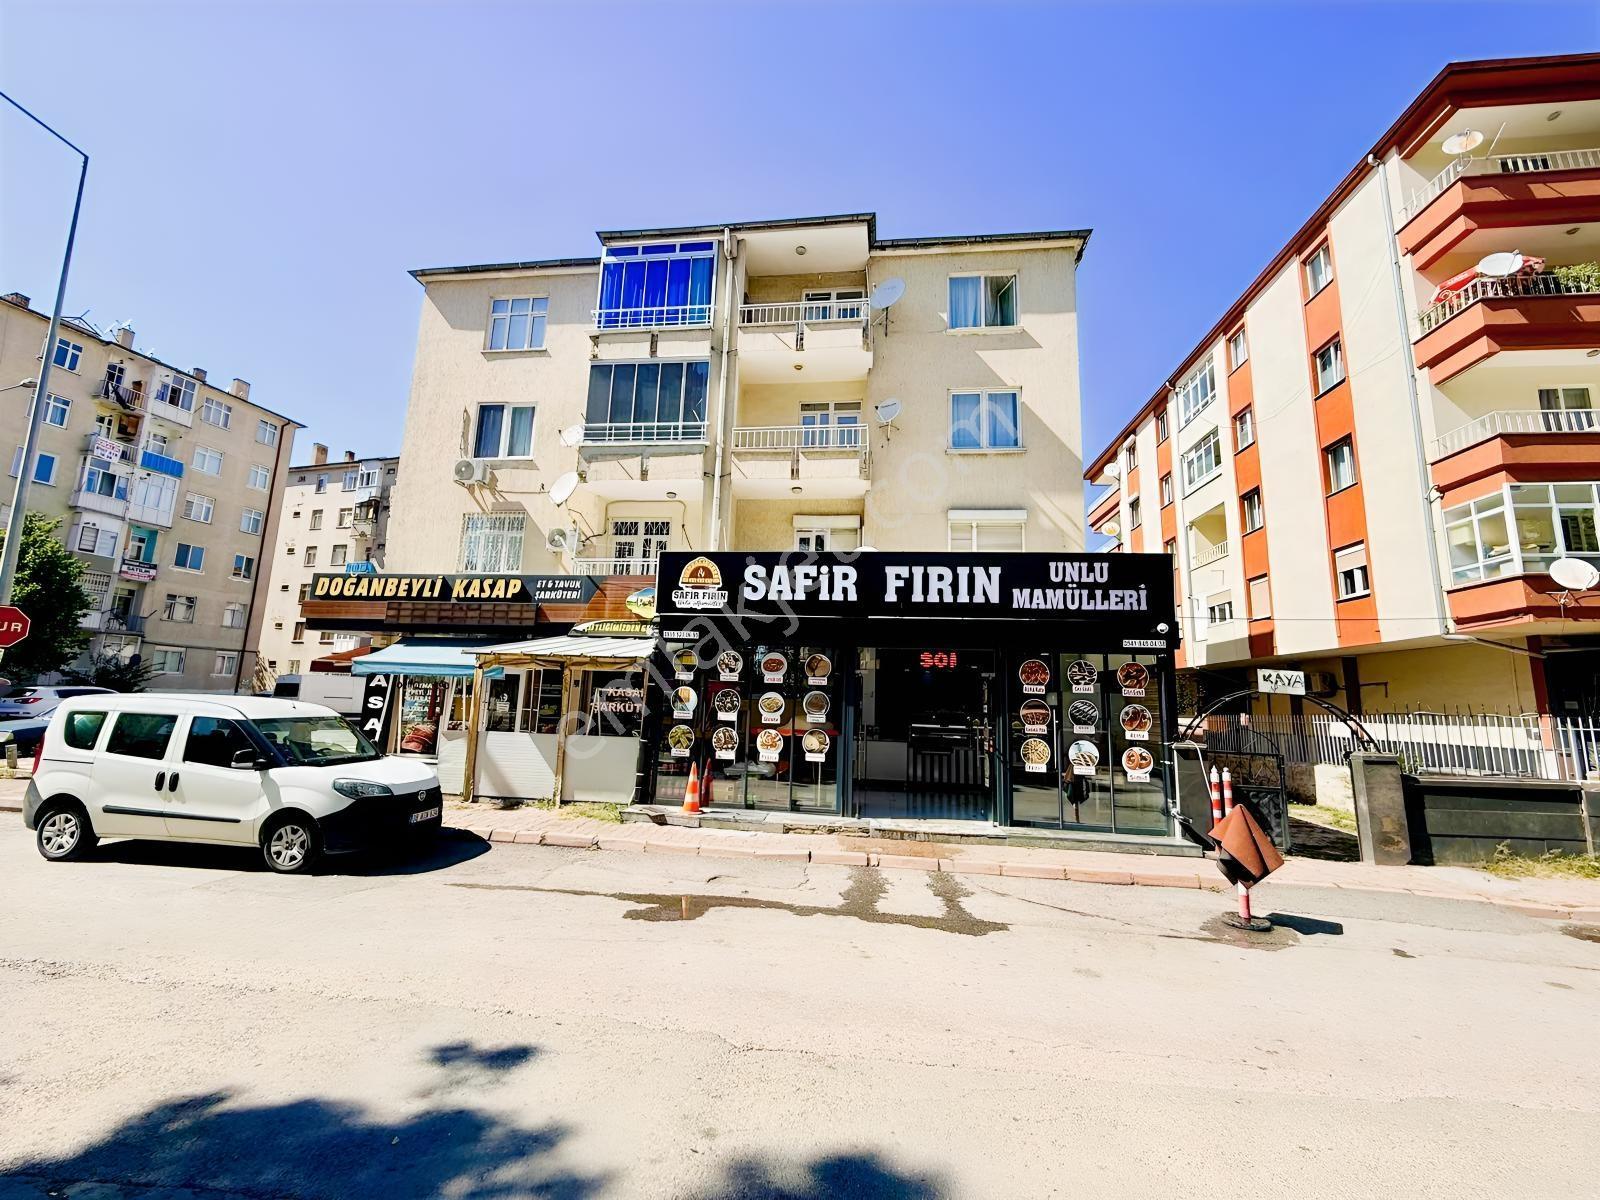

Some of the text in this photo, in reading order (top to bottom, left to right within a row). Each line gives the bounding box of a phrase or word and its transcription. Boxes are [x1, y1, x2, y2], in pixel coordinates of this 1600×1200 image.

[1049, 561, 1109, 583] UNLU
[314, 573, 522, 599] DOĞANBEYLİ KASAP
[536, 579, 581, 589] ET & TAVUK
[884, 565, 1002, 604] FIRIN
[534, 589, 581, 600] ŞARKÜTERİ
[702, 591, 727, 600] FIRIN
[1012, 584, 1148, 611] MAMÜLLERİ
[1262, 673, 1304, 688] KAYA
